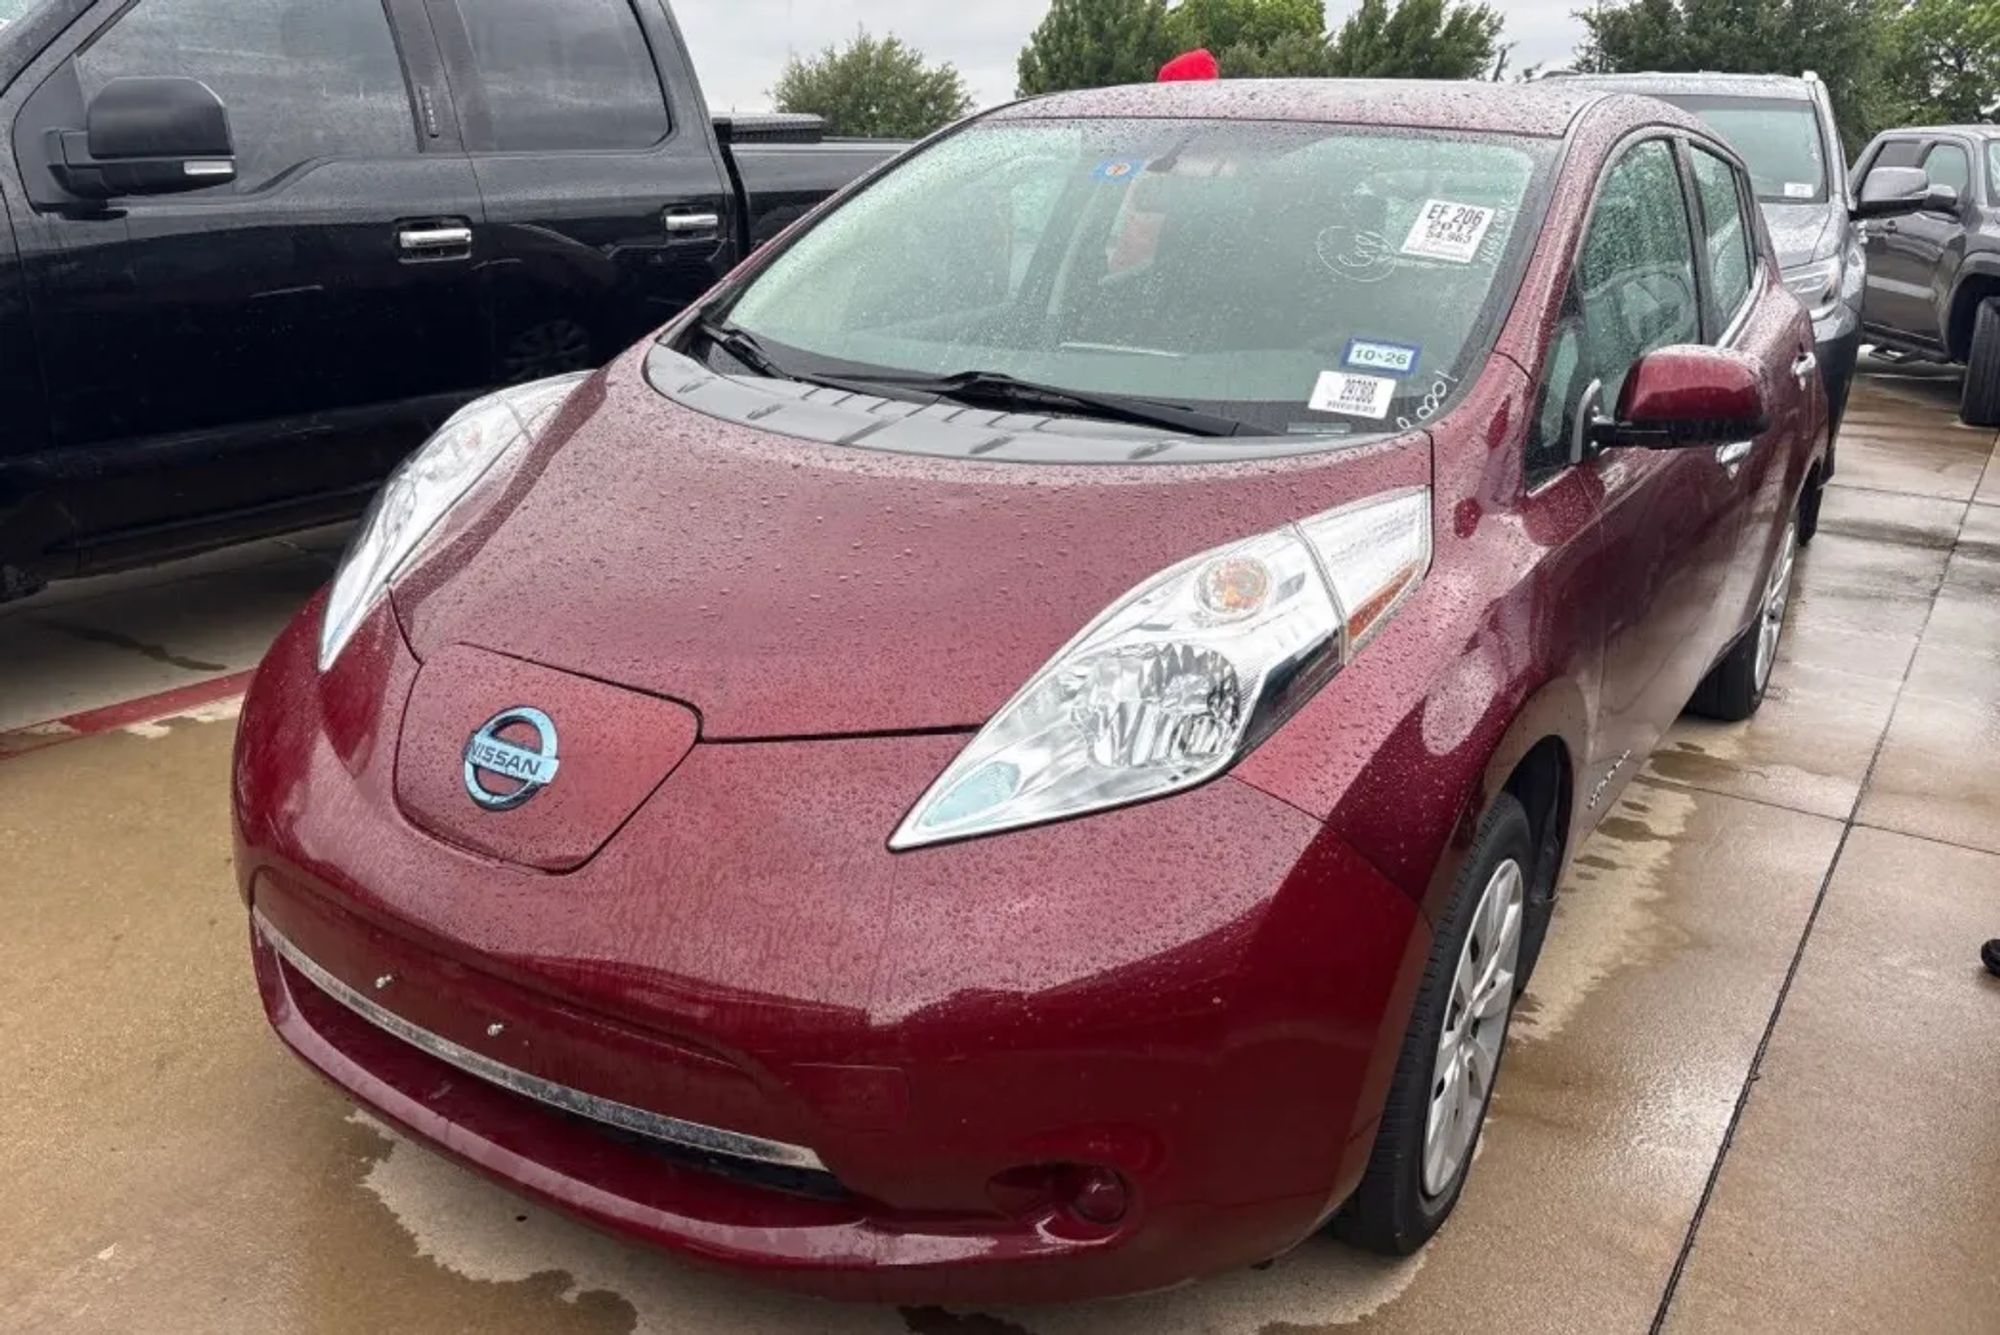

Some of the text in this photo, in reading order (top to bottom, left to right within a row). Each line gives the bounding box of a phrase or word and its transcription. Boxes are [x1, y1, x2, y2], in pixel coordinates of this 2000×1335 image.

[1427, 204, 1485, 226] EF 206
[468, 741, 541, 776] NISSAN
